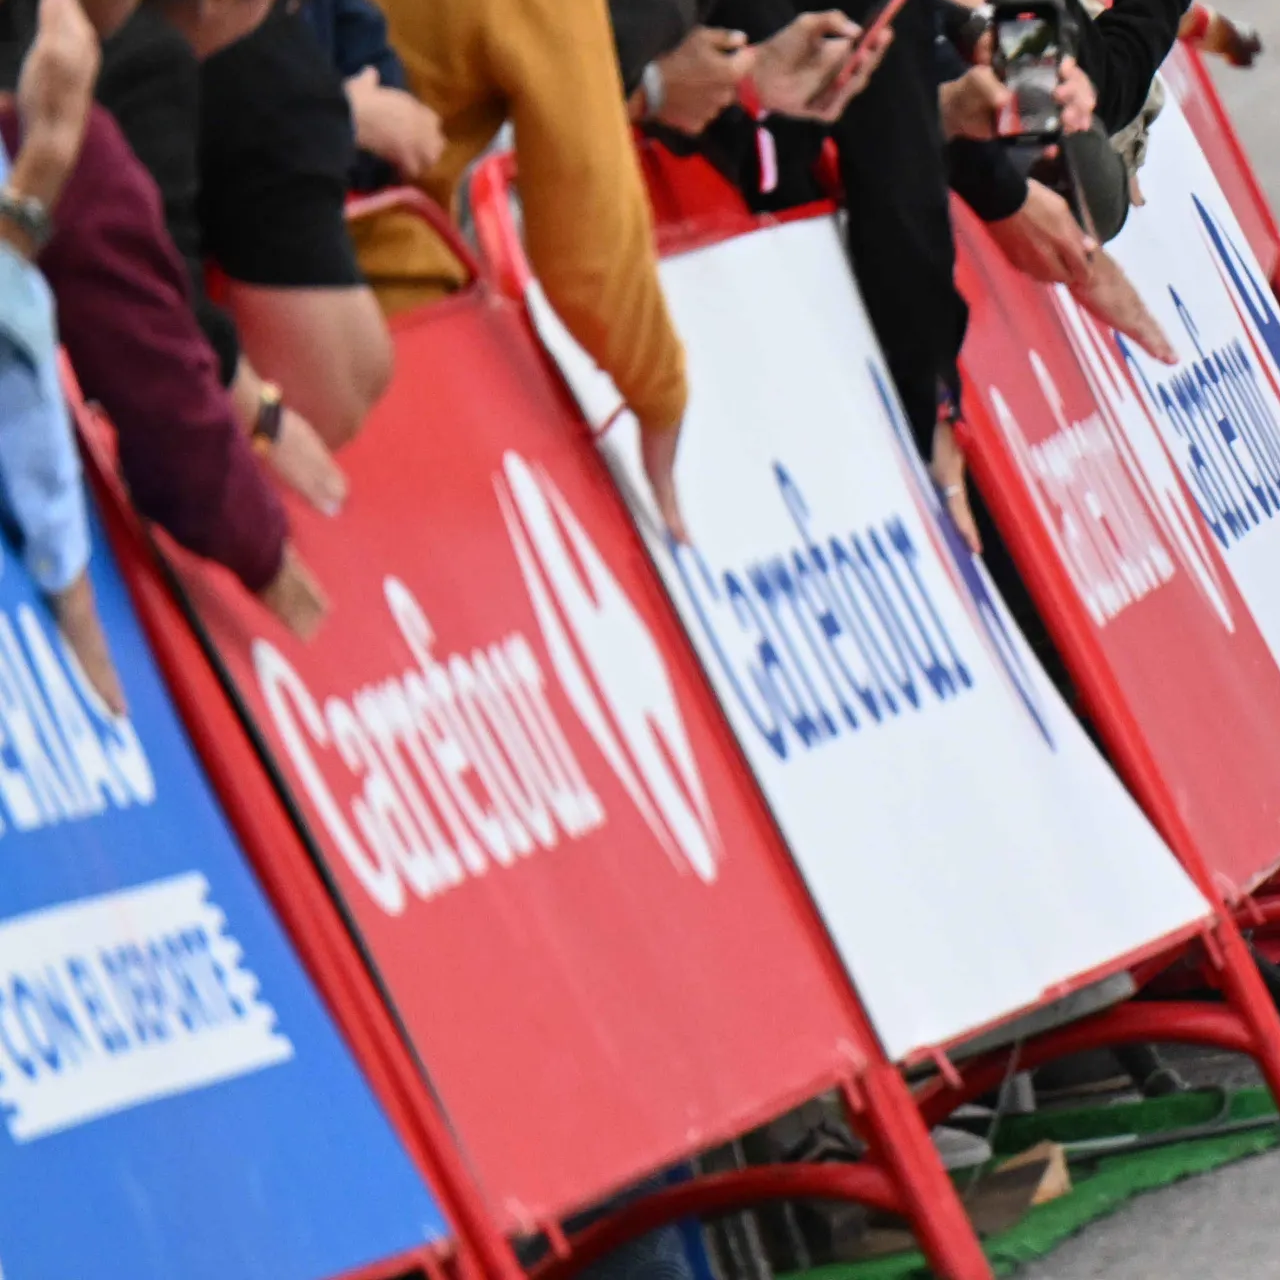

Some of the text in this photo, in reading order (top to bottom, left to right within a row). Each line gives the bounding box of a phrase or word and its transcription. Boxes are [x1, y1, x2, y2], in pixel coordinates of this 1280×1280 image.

[669, 460, 973, 763] Carrefour
[987, 347, 1176, 628] Carrefour
[251, 576, 606, 917] Carrefour
